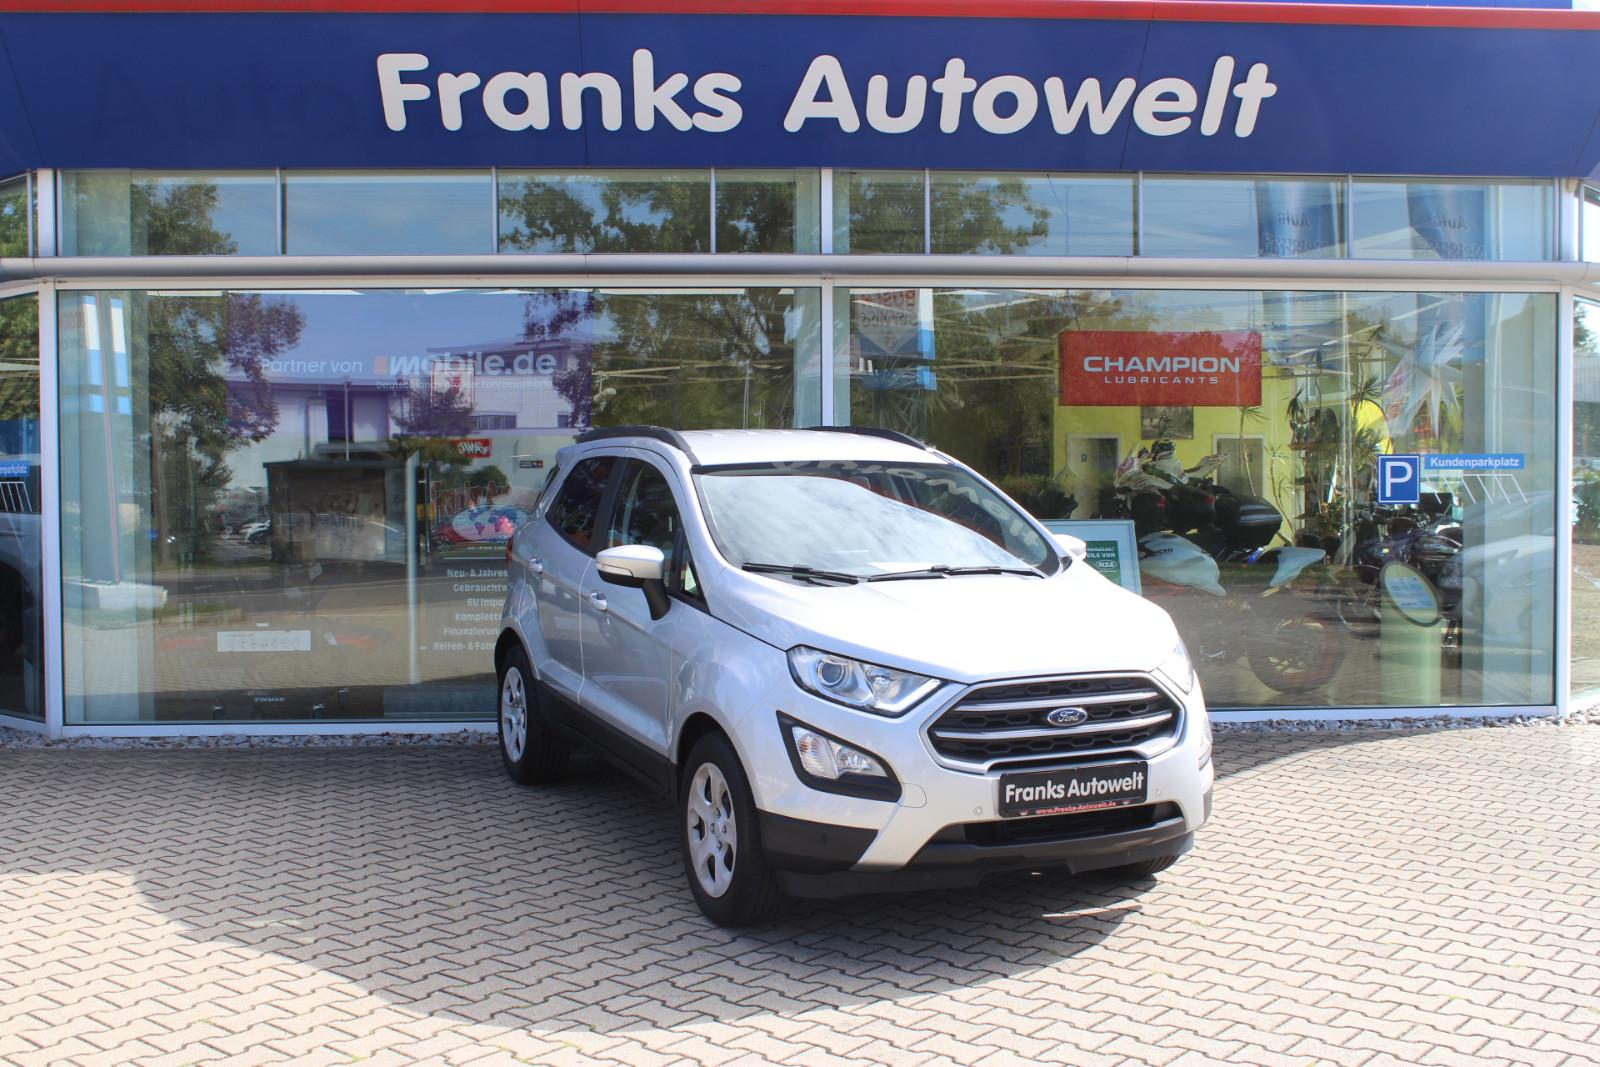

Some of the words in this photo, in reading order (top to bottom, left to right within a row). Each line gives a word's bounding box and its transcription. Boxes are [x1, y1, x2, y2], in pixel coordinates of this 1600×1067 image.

[378, 49, 742, 132] Franks
[784, 56, 1277, 137] Autowelt
[262, 357, 327, 373] Partner
[330, 361, 363, 373] von
[389, 351, 557, 376] mobile.de
[1083, 356, 1241, 373] CHAMPION
[1104, 376, 1219, 384] LUBRICANTS
[1430, 457, 1521, 468] Kundenparkplatz
[1385, 461, 1413, 498] P
[447, 568, 470, 577] Neu-
[477, 568, 508, 577] Jahres
[467, 598, 479, 607] EU
[443, 627, 498, 636] Finanzierun
[1058, 711, 1080, 722] Ford
[1005, 780, 1065, 803] Franks
[1067, 771, 1144, 798] Autowelt
